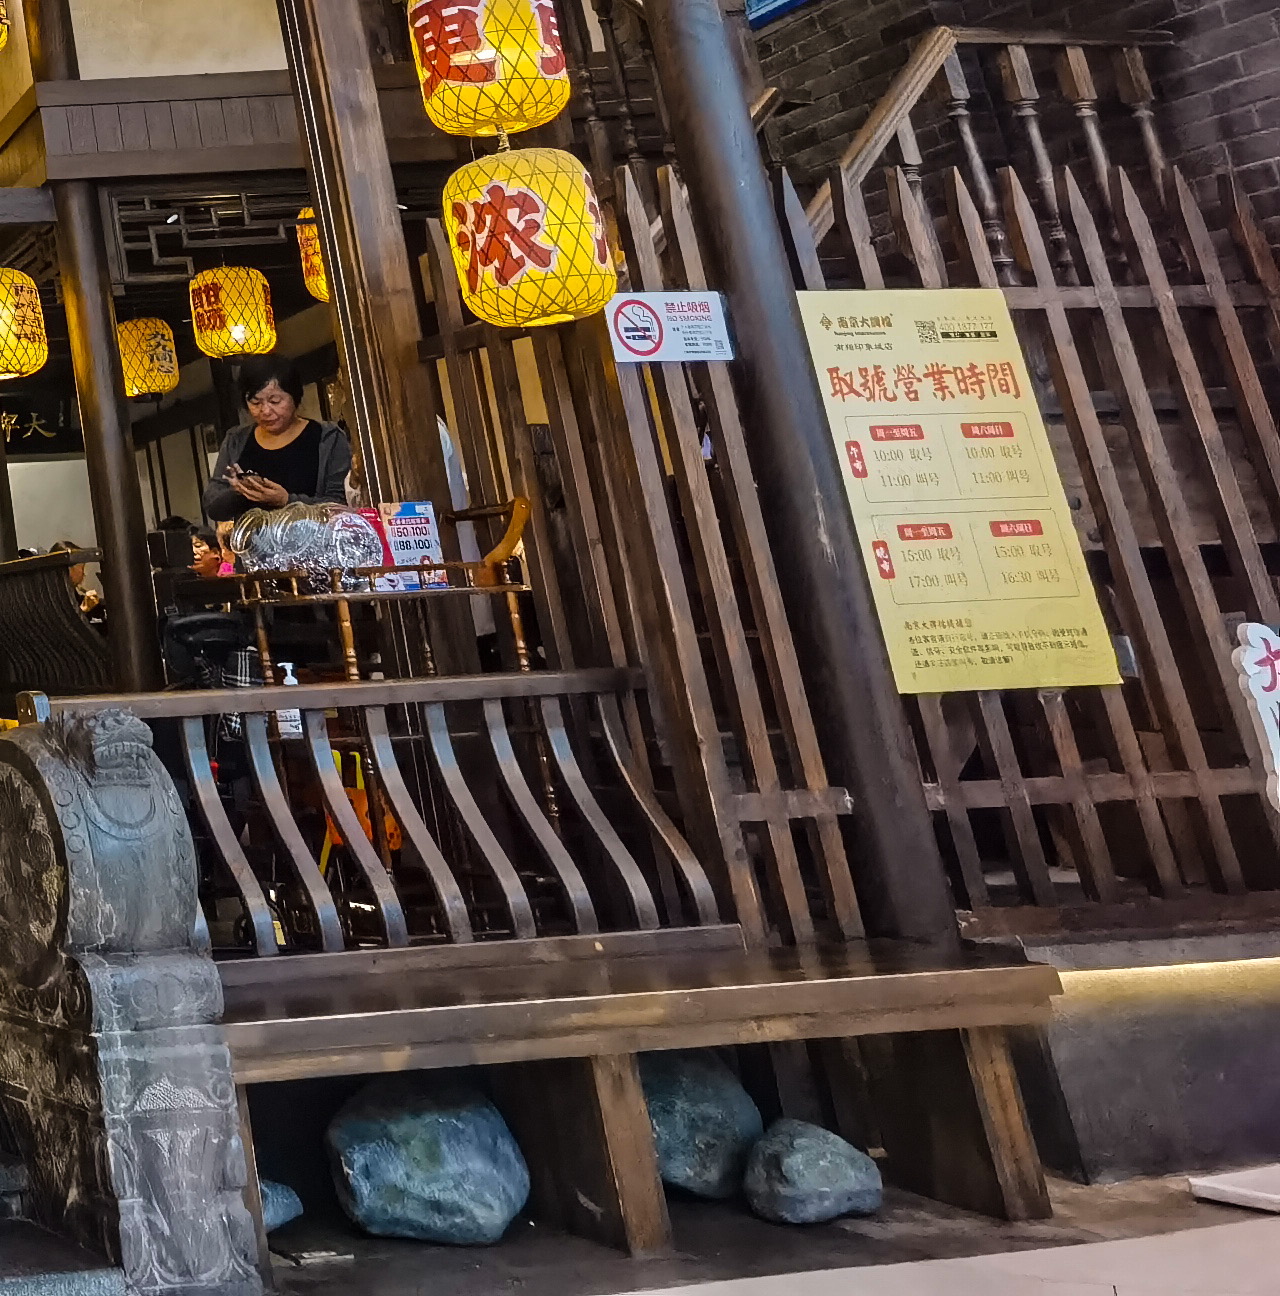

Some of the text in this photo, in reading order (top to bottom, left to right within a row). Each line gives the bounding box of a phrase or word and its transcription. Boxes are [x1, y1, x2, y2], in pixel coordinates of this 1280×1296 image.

[452, 184, 556, 294] 浓
[665, 301, 710, 313] 禁止吸烟
[827, 362, 1020, 402] 取號營業時間
